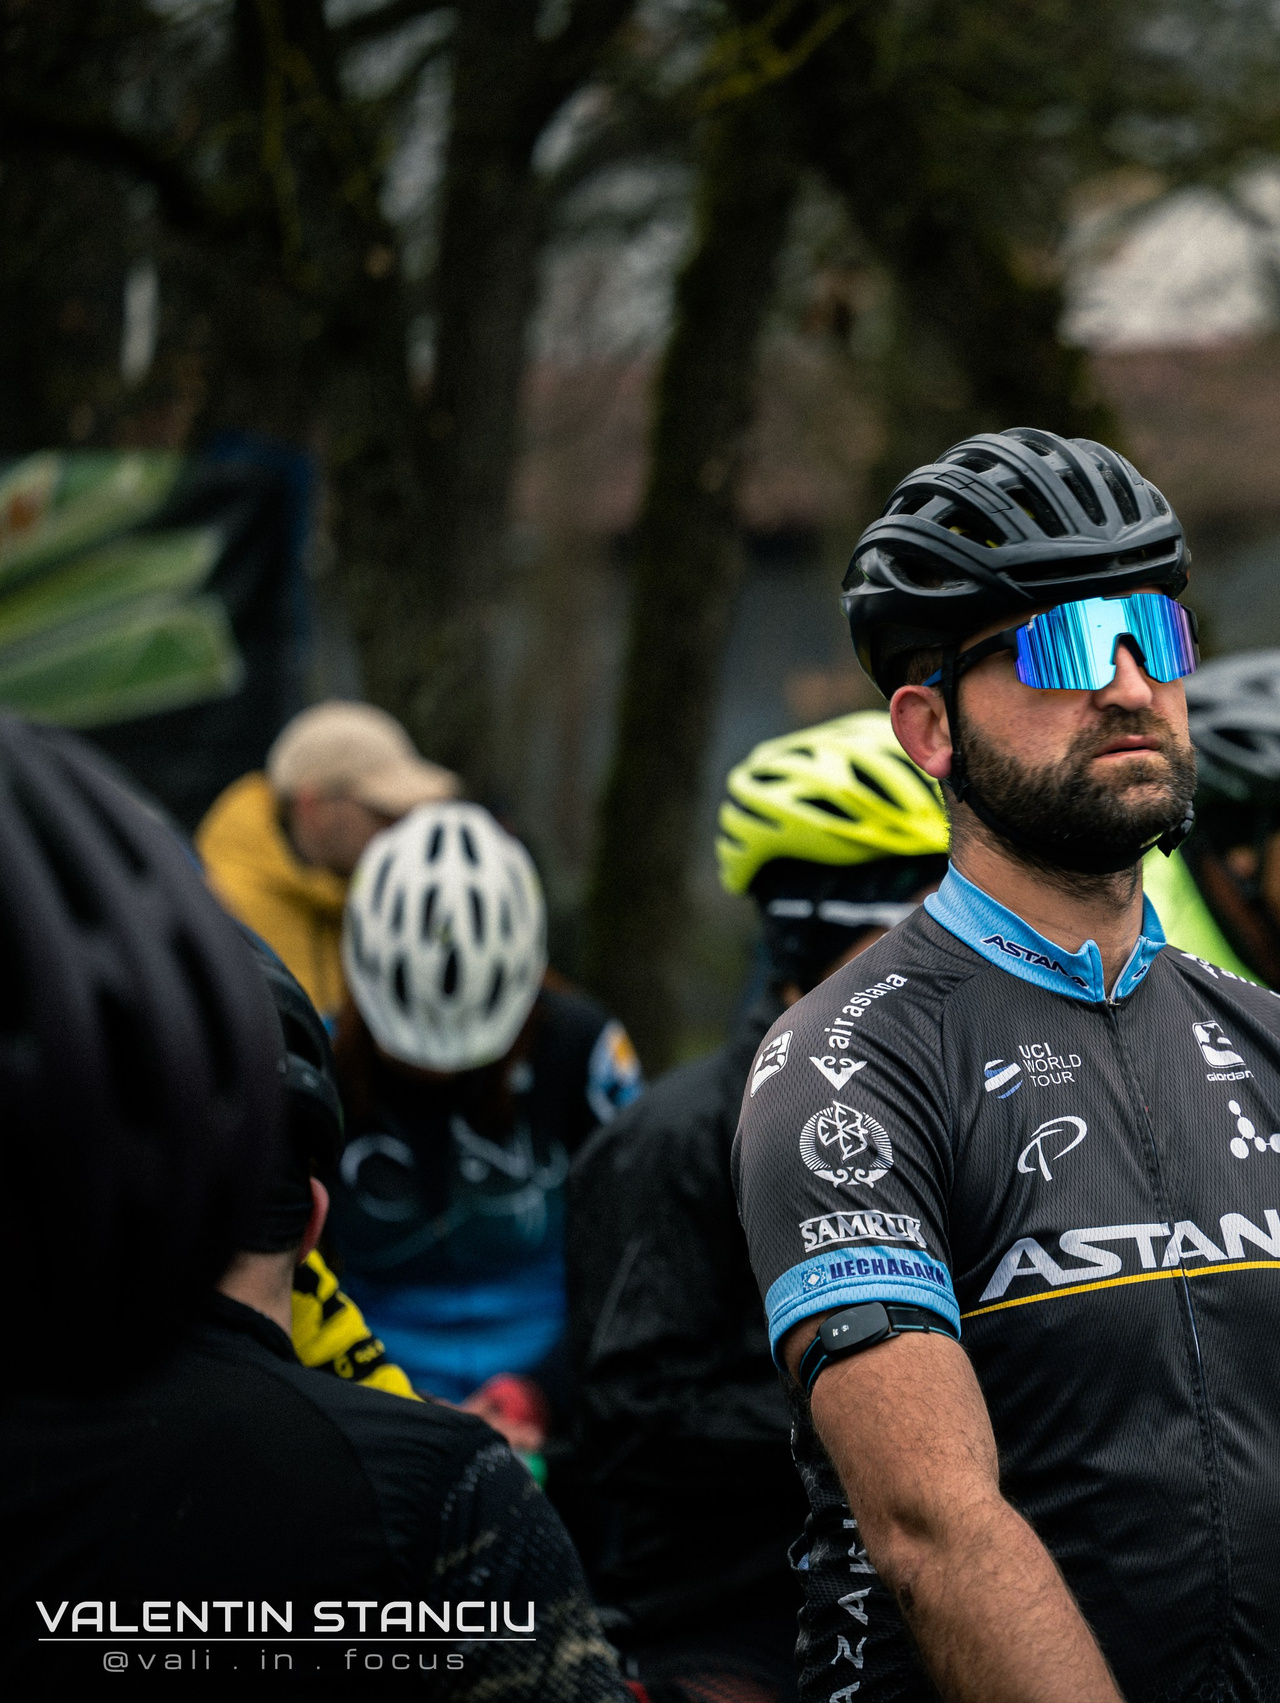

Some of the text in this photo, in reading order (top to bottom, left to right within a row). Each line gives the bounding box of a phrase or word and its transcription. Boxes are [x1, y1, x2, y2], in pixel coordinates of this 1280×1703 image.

[981, 934, 1089, 988] ASTANA
[824, 972, 908, 1051] air astana
[1019, 1043, 1053, 1059] UCI
[1022, 1054, 1082, 1072] WORLD
[1029, 1071, 1076, 1088] TOUR
[799, 1210, 927, 1252] SAMRUK
